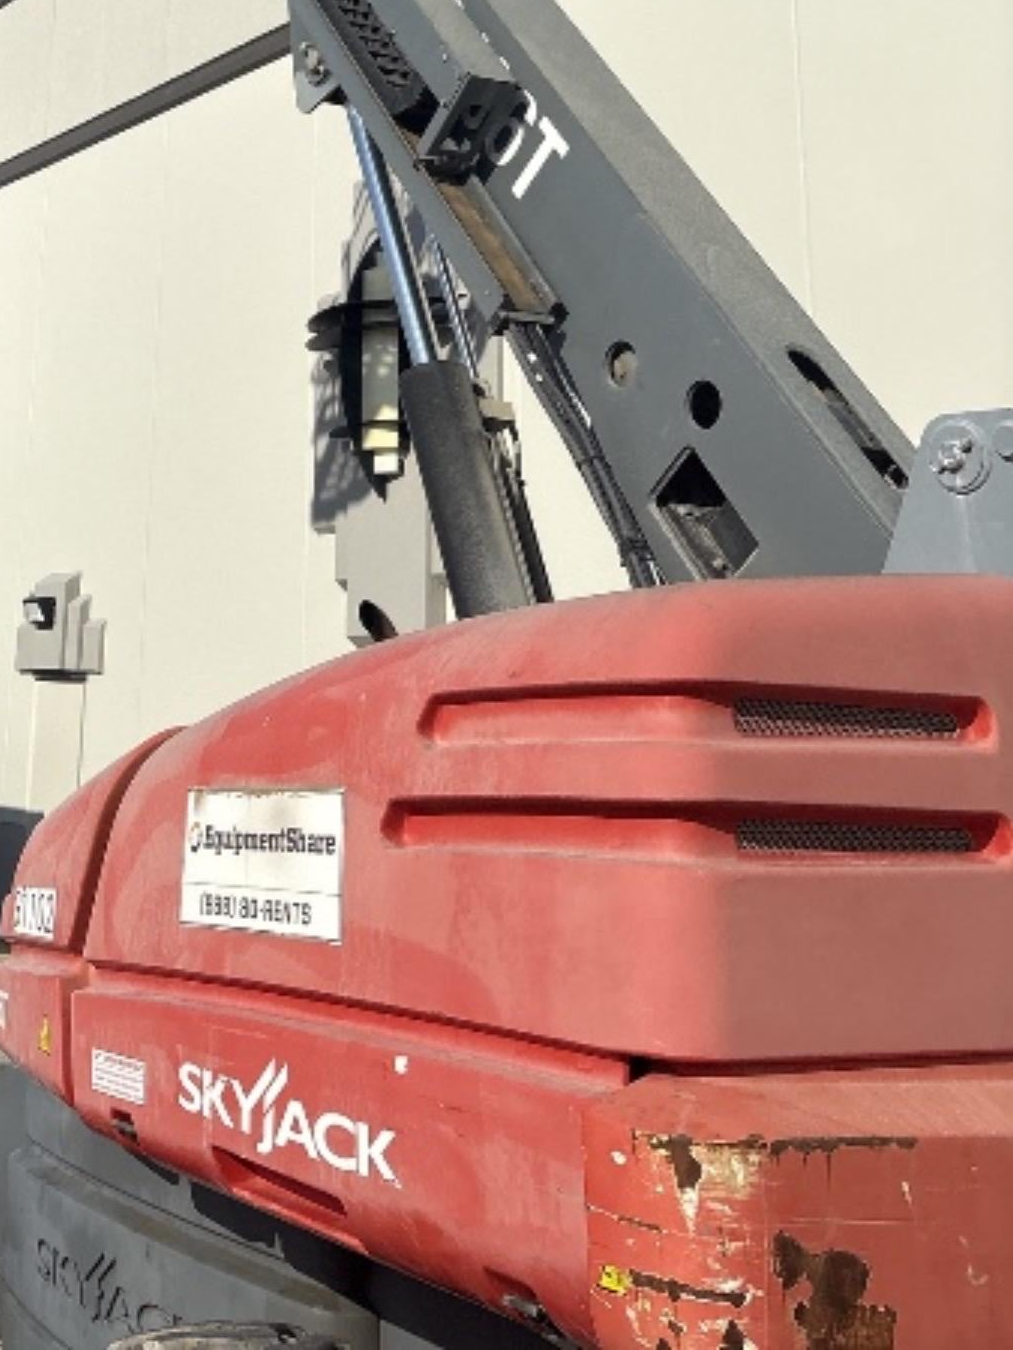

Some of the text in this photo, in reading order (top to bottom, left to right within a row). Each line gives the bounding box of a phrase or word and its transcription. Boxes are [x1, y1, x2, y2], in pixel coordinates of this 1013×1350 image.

[204, 823, 336, 856] EquipmentShare
[178, 1058, 397, 1183] SKYJACK
[36, 1237, 183, 1334] SKYJAC
